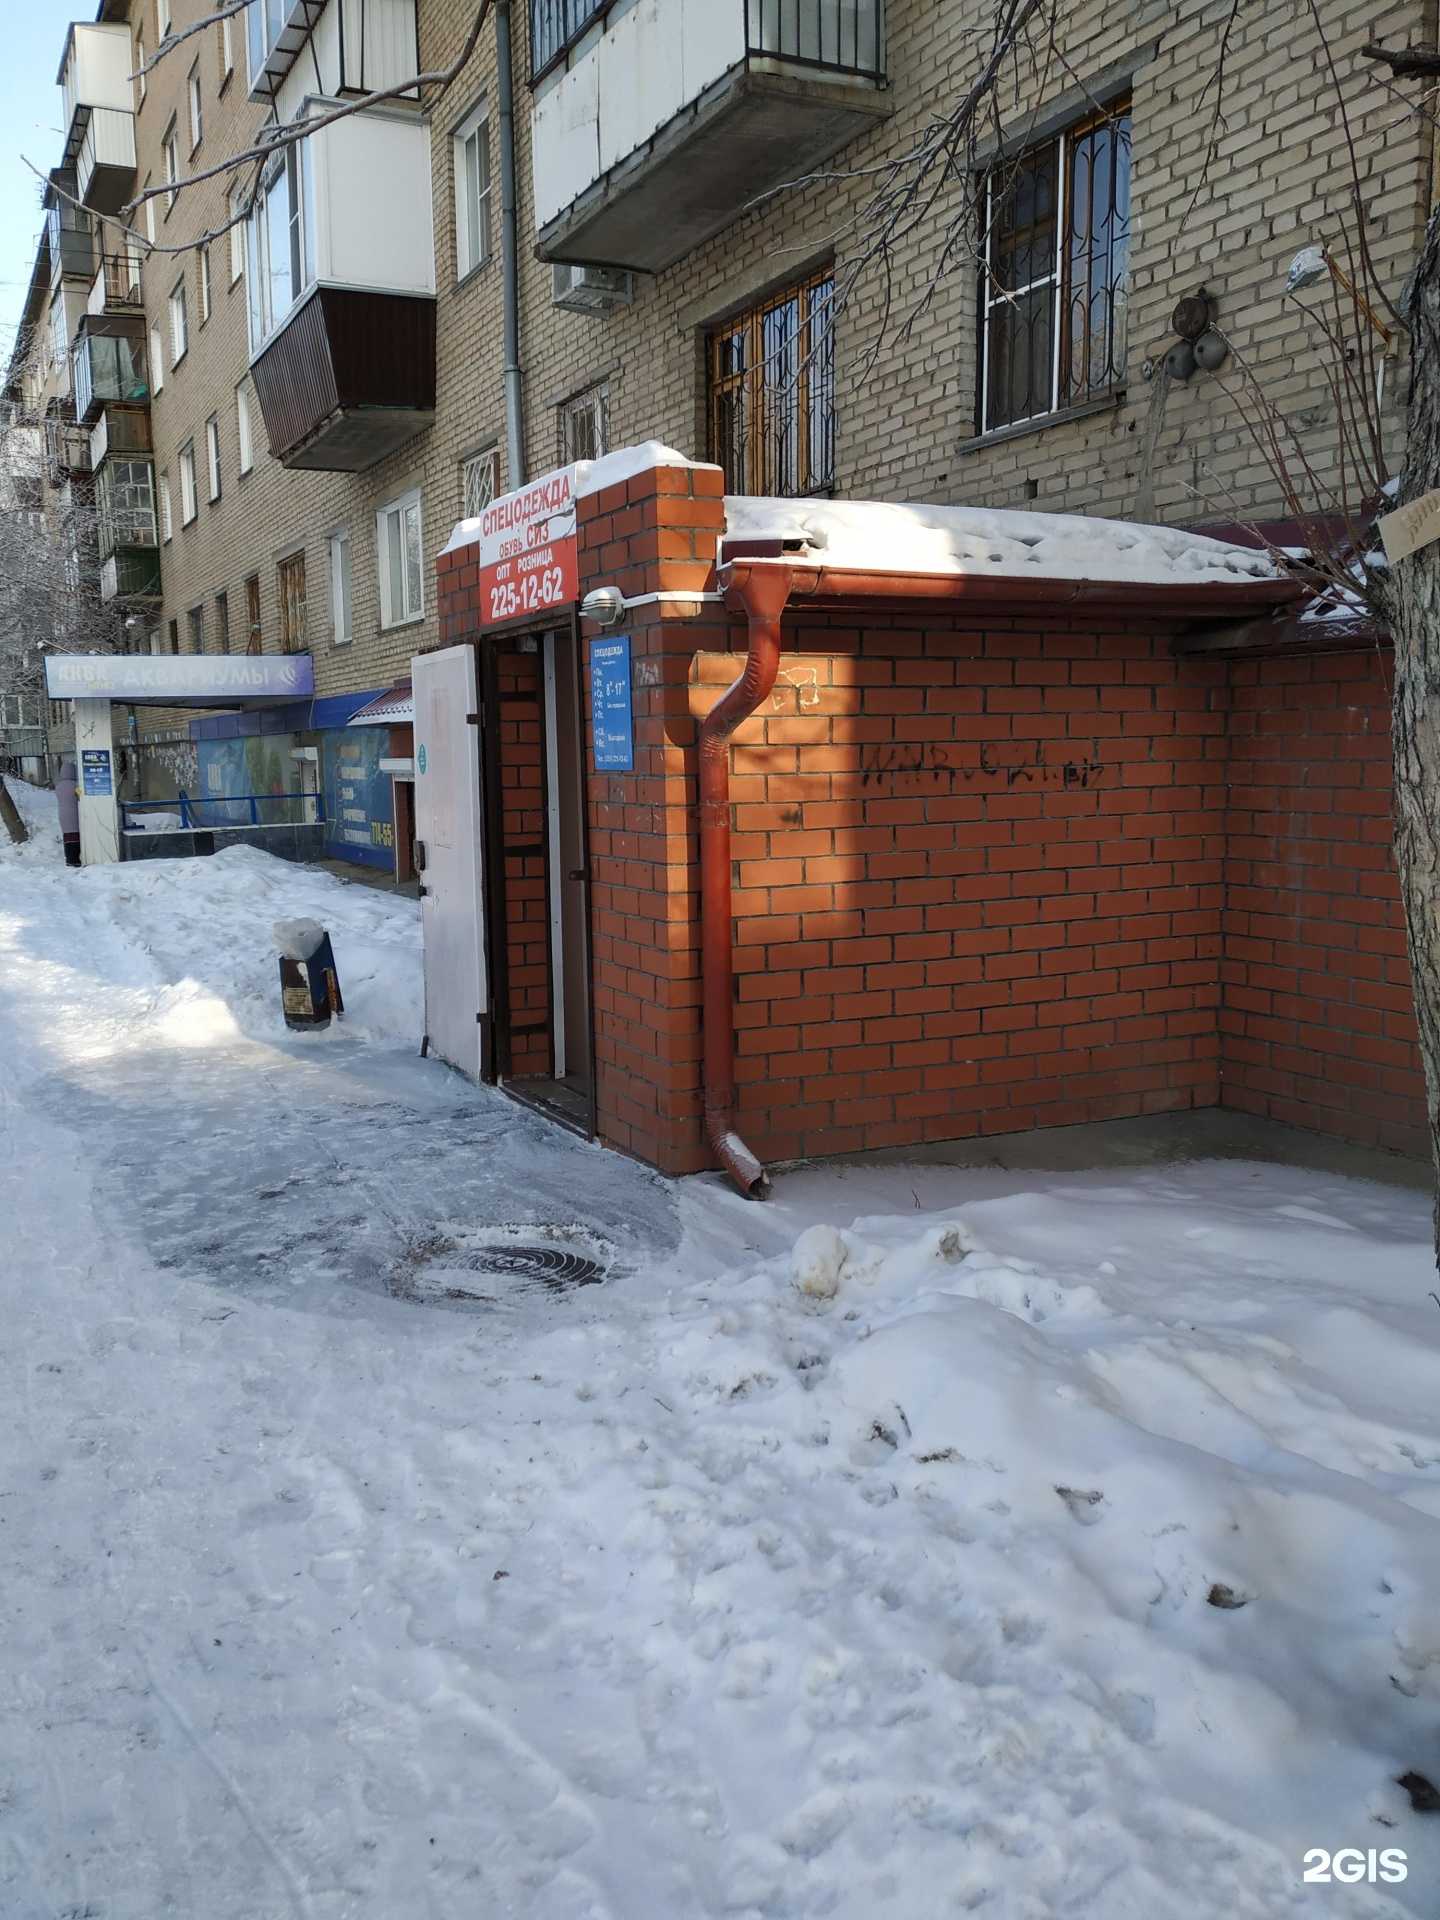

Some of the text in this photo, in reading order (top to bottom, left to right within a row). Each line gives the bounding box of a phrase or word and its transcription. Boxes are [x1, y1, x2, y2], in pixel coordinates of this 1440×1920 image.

[482, 475, 570, 537] СПЕЦОДЕЖДА
[499, 521, 550, 559] ОБУВЬ СИЗ
[496, 547, 553, 581] ОПТ РОЗНИЦА
[490, 566, 563, 619] 225-12-62
[122, 666, 270, 688] АКВАРИУМЫ
